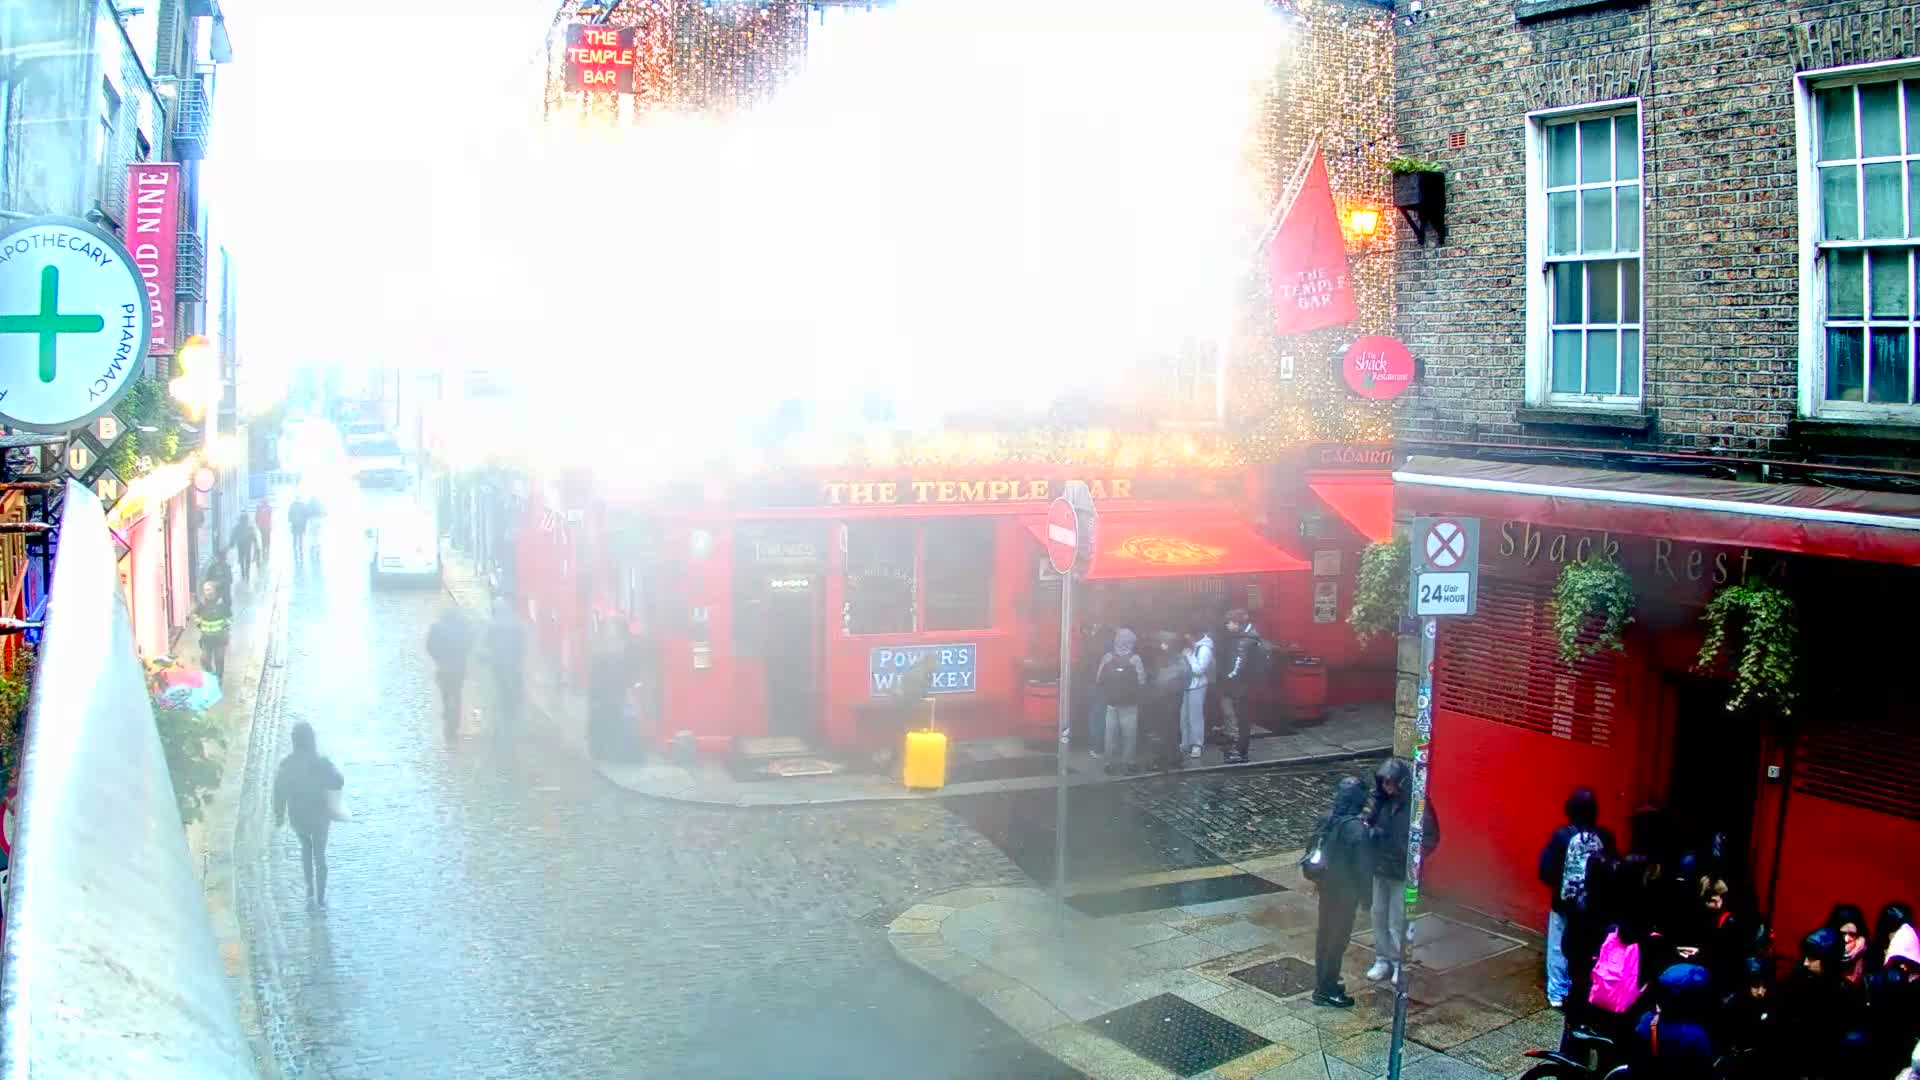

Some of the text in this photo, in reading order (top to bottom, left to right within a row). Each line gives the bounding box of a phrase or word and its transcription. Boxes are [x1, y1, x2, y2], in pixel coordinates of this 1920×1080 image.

[584, 30, 616, 46] THE
[568, 48, 632, 65] TEMPLE
[583, 70, 616, 85] BAR
[137, 172, 169, 233] NINE
[1298, 268, 1328, 281] THE
[88, 303, 136, 402] PHARMACY
[825, 481, 897, 504] THE
[911, 480, 1049, 502] TEMPLE
[1500, 519, 1619, 565] Shack
[1421, 584, 1442, 603] 24
[1443, 595, 1465, 603] HOUR
[879, 648, 969, 668] POWR'S
[873, 671, 972, 691] WKEY
